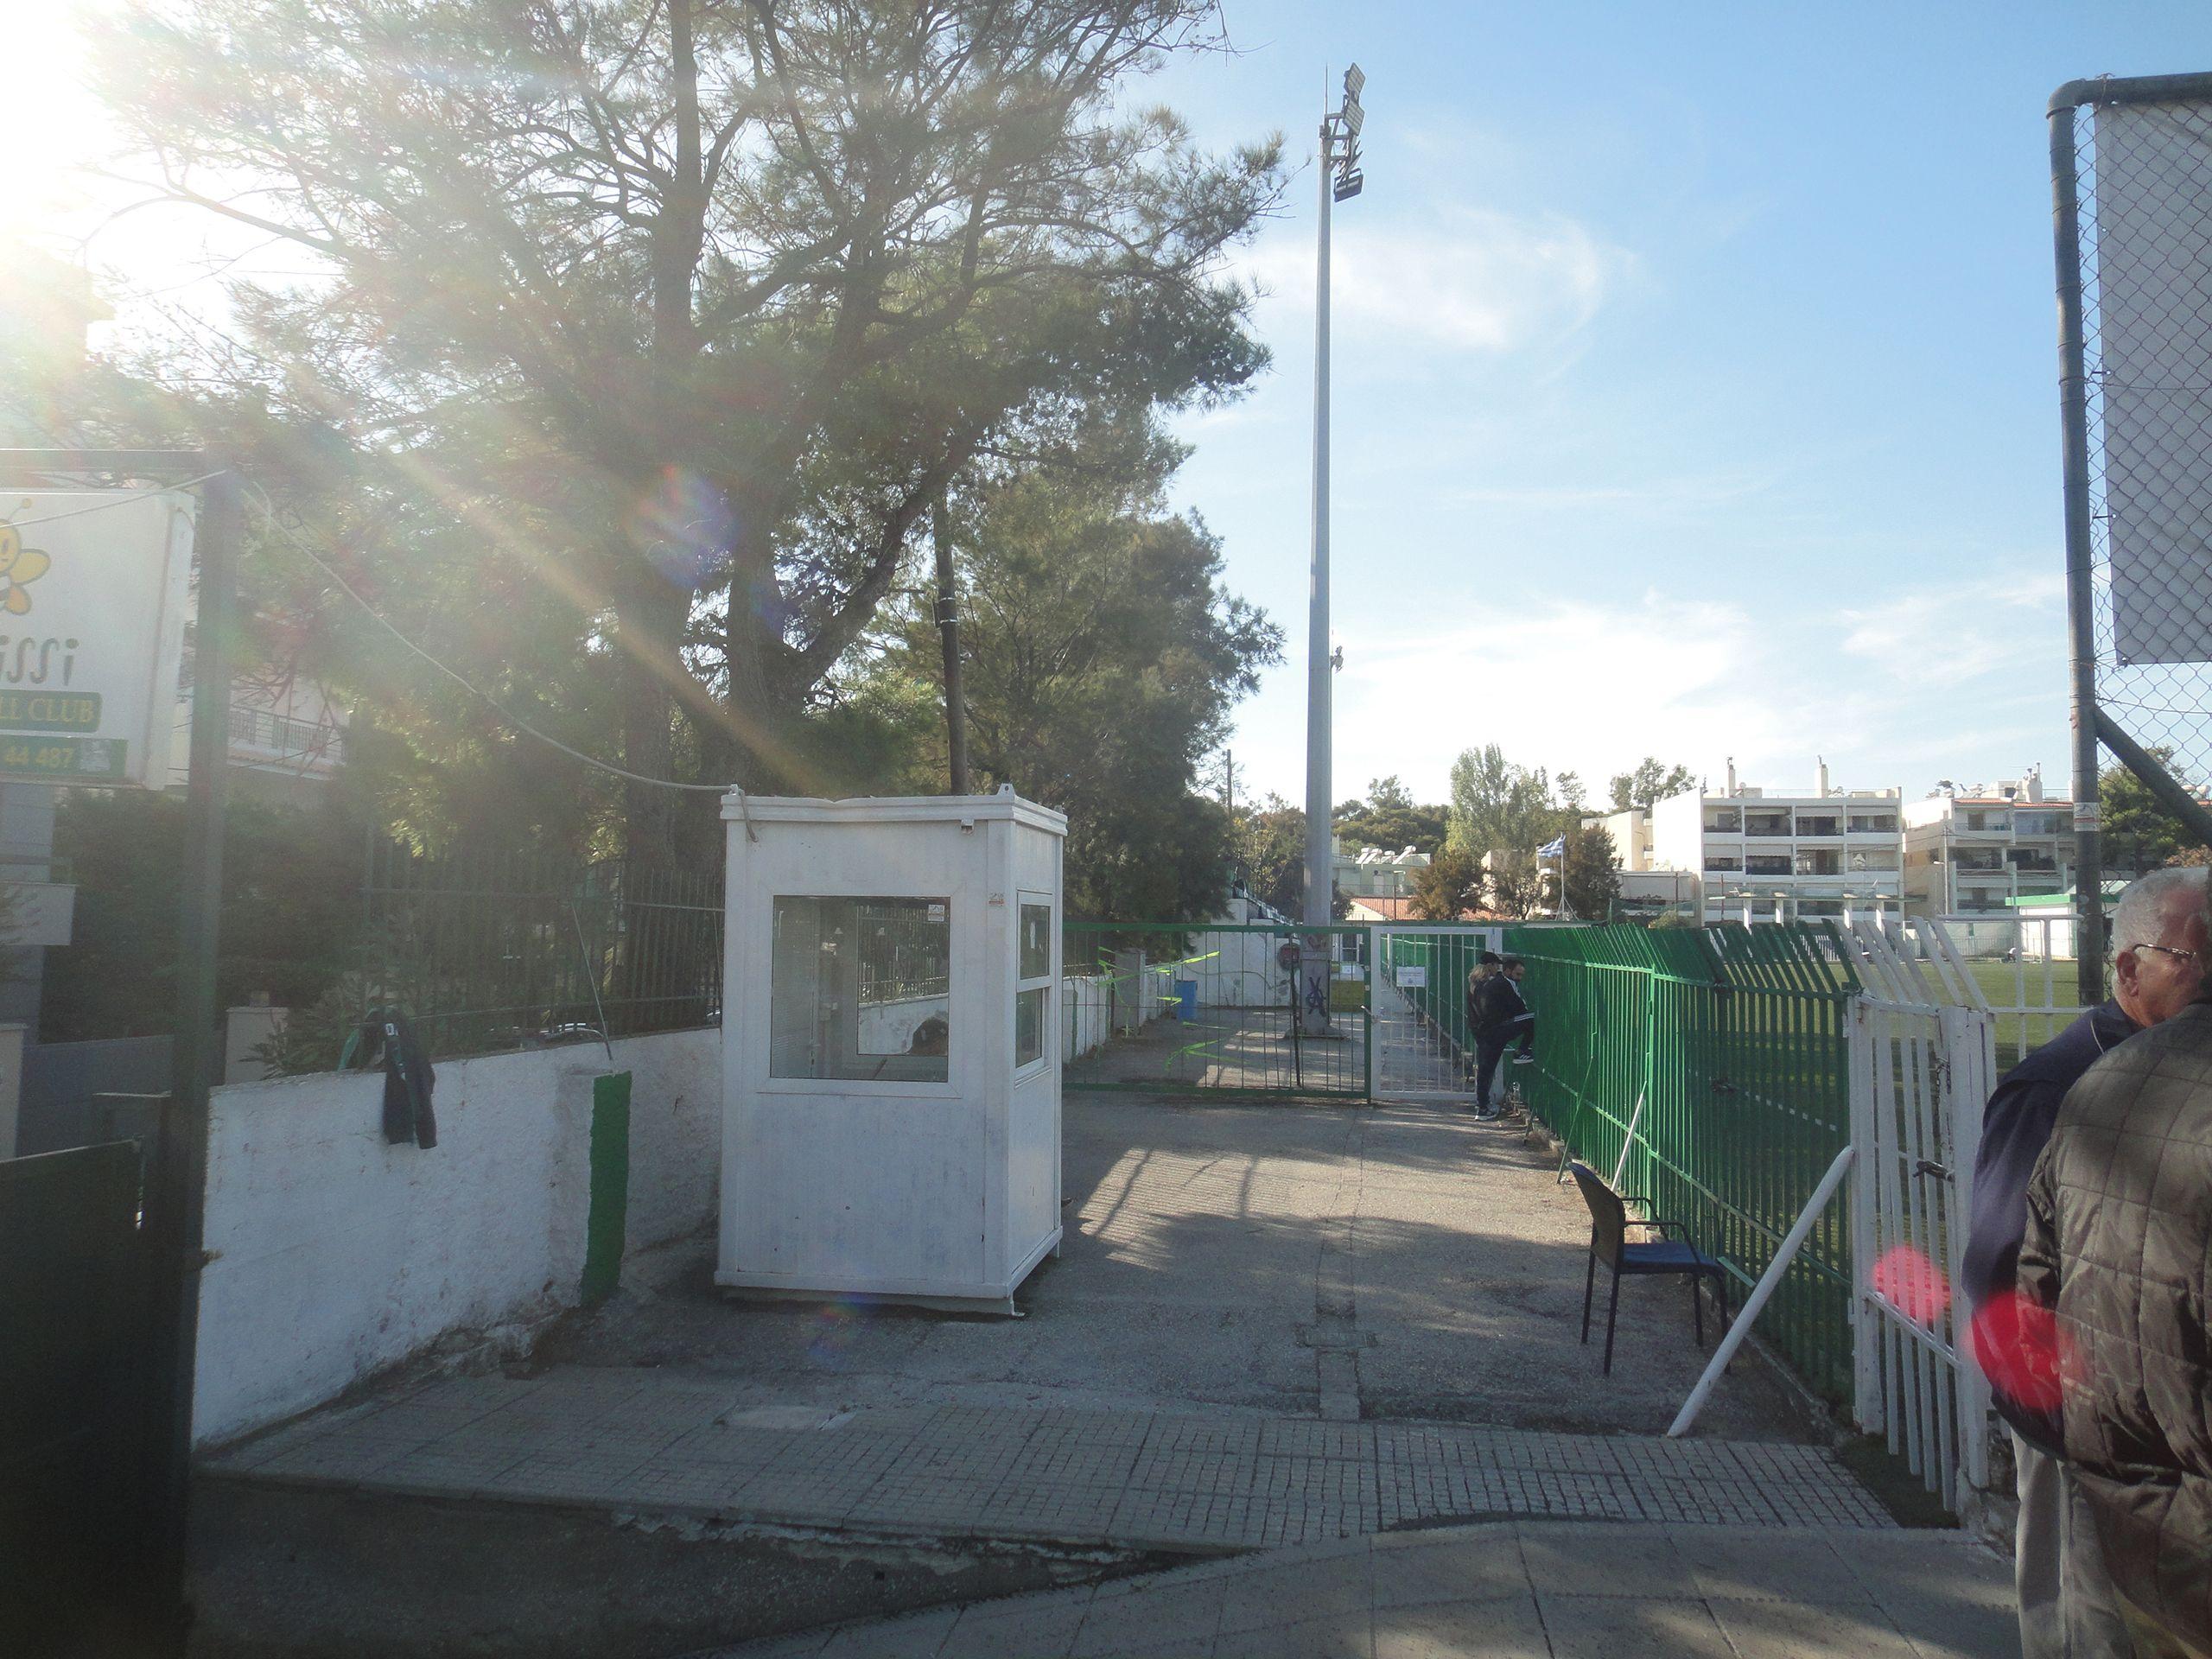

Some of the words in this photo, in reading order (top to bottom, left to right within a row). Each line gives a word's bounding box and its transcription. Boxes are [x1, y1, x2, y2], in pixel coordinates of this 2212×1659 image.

[28, 698, 94, 723] CLUB
[4, 746, 29, 766] 44
[35, 747, 74, 768] 487
